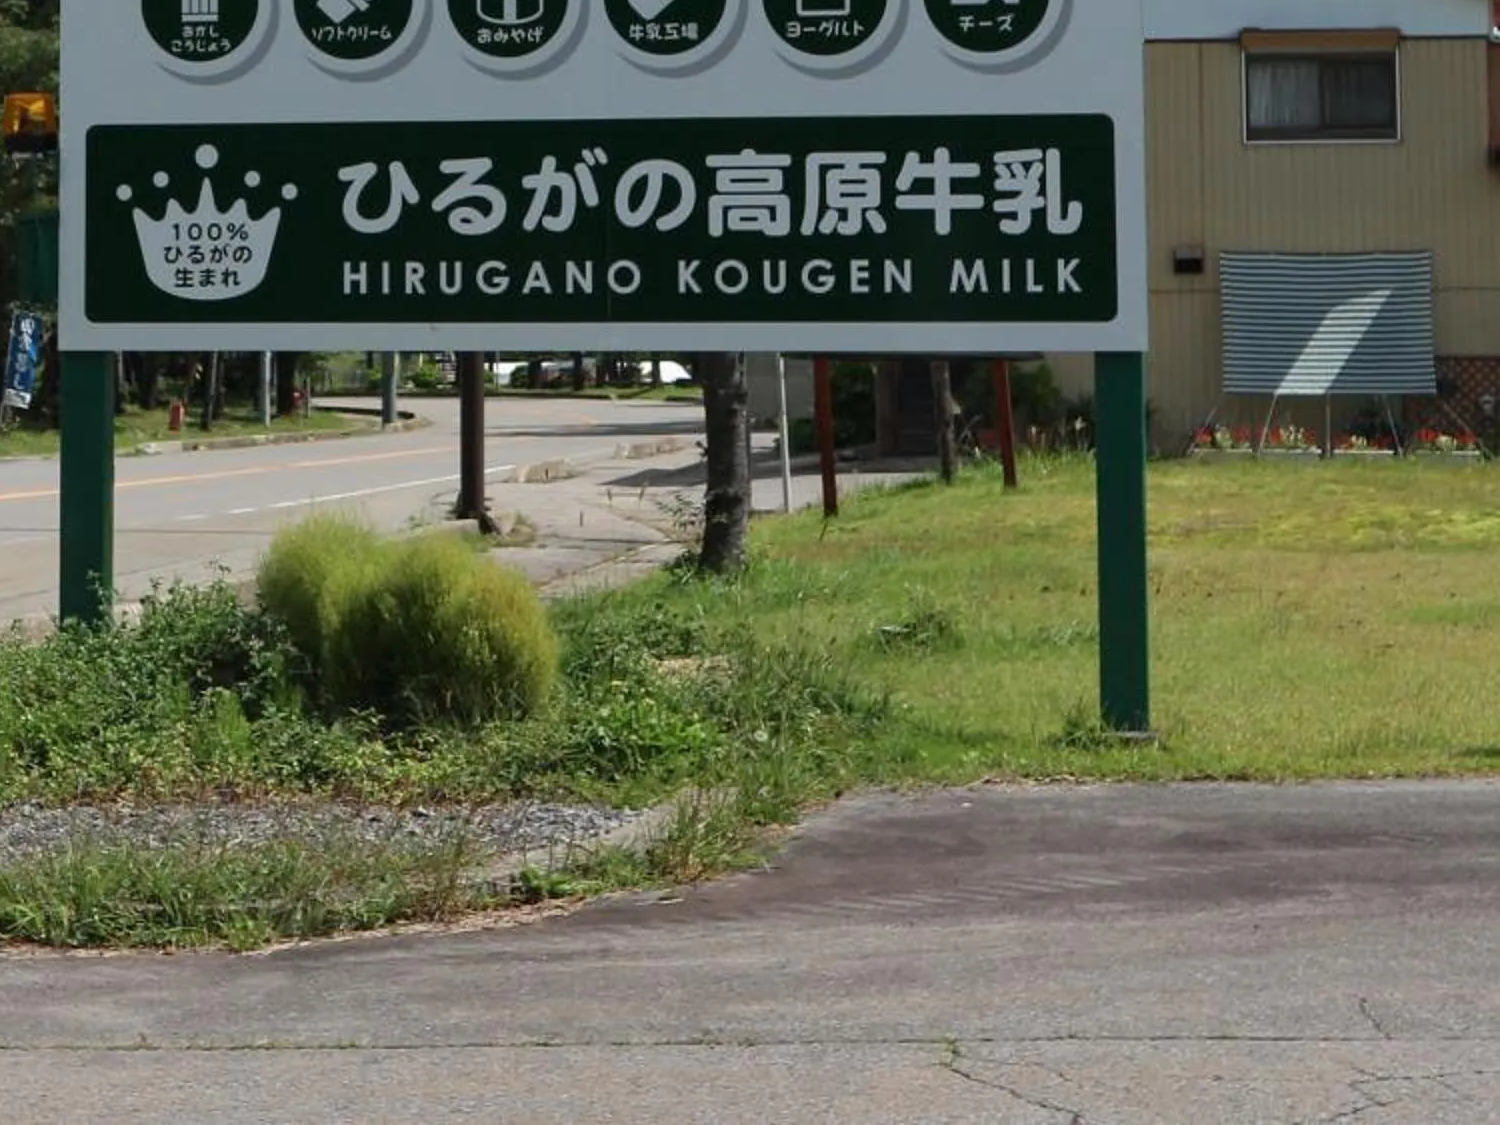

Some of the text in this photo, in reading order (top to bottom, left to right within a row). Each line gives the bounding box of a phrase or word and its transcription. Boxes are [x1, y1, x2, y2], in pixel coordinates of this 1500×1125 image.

[786, 20, 864, 37] ヨーグルト
[958, 14, 1013, 33] チーズ
[311, 25, 392, 43] ソフトクリーム
[476, 26, 544, 44] おみやげ
[171, 38, 231, 53] こうじょう
[338, 147, 1083, 237] ひるがの高原牛乳
[172, 222, 249, 242] 100%
[163, 244, 253, 265] ひるがの
[174, 267, 241, 288] 生まれ
[343, 258, 1081, 294] HIRUGANO KOUGEN MILK
